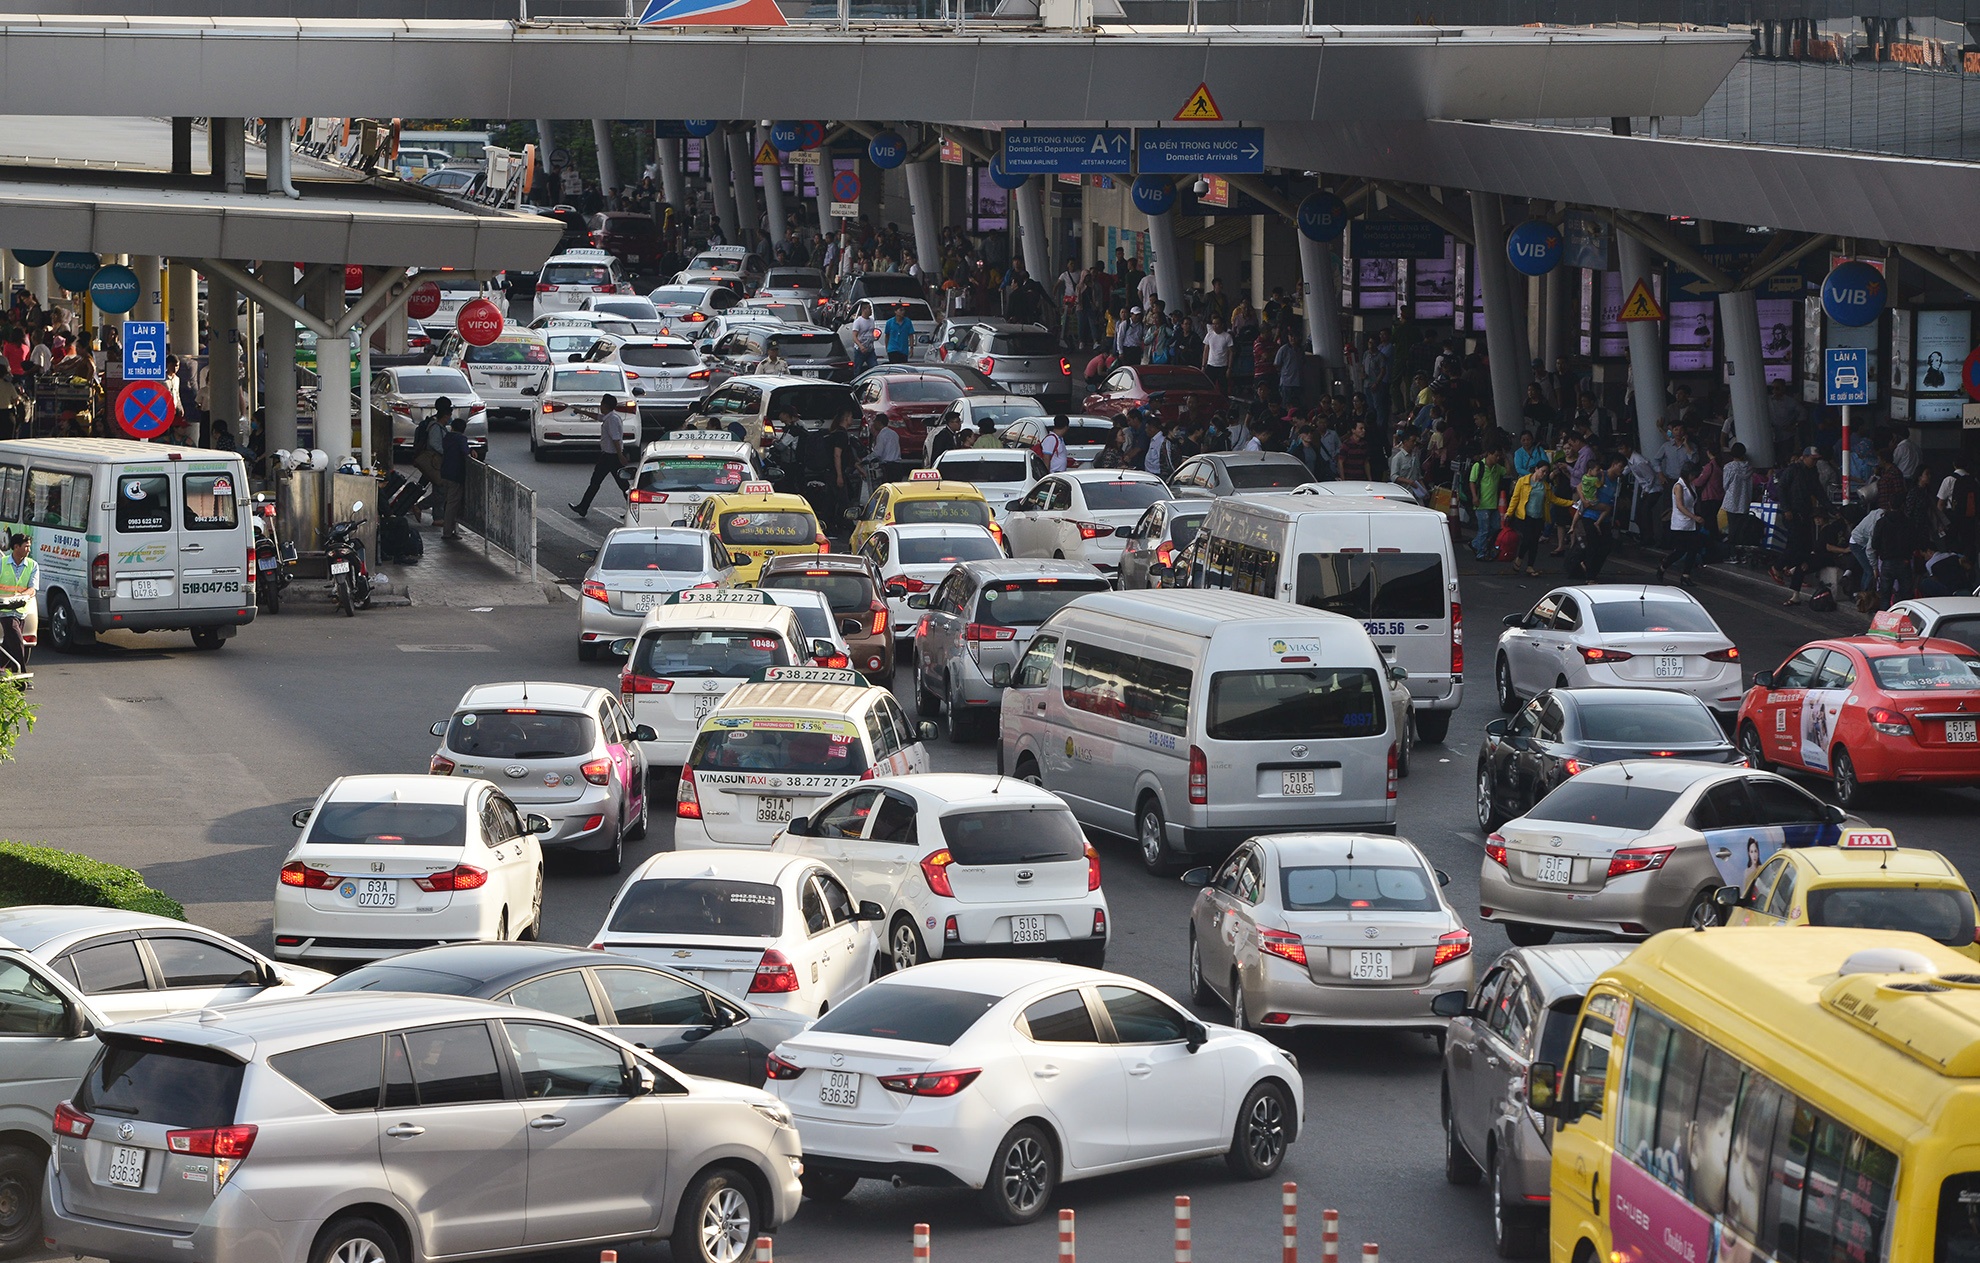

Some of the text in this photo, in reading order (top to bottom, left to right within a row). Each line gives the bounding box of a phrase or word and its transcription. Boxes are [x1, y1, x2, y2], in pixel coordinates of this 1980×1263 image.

[775, 132, 795, 140] VIB
[1008, 135, 1086, 144] GA ĐI TRONG NƯỚC
[1090, 134, 1108, 154] A
[1144, 139, 1238, 150] GA ĐẾN TRONG NƯỚC
[875, 146, 896, 157] VIB
[1044, 146, 1084, 154] Departures
[1138, 188, 1163, 201] VIB
[1305, 213, 1332, 226] VIB
[1516, 242, 1546, 258] VIB
[54, 262, 96, 270] ABBANK
[92, 282, 136, 290] ABBANK
[1832, 287, 1867, 305] VIB
[132, 324, 156, 335] LÀN B
[468, 321, 498, 329] VIFON
[1834, 350, 1850, 362] LÀN
[1964, 416, 1980, 425] KHÔN
[746, 484, 770, 493] TAXI
[755, 526, 796, 535] 36 36 36 36
[40, 544, 51, 553] SPA
[138, 581, 152, 589] 51B
[134, 589, 158, 598] 047.63
[641, 594, 655, 602] 85A
[698, 592, 760, 602] 38.27 27 27
[752, 639, 775, 648] 10484
[1662, 657, 1677, 666] 51G
[786, 670, 854, 681] 38.27 27 27
[1656, 666, 1683, 676] 061.77
[1343, 712, 1373, 727] 4897
[1953, 721, 1969, 732] 51F
[1947, 732, 1976, 742] 813.95
[1074, 744, 1092, 761] VIAGS
[787, 777, 818, 787] 38.27
[822, 778, 836, 787] 27
[837, 778, 855, 788] 27
[1290, 772, 1307, 783] 51B
[1284, 783, 1314, 794] 249.65
[766, 799, 784, 809] 51A
[758, 809, 791, 822] 398.46
[1852, 835, 1888, 845] TAXI
[1545, 859, 1563, 868] 51F
[1538, 869, 1568, 883] 448.09
[368, 880, 388, 892] 63A
[359, 893, 396, 905] 070.75
[1019, 917, 1037, 929] 51G
[1013, 929, 1045, 943] 293.65
[1361, 952, 1382, 964] 51G
[1353, 965, 1388, 978] 457.51
[831, 1074, 850, 1089] 60A
[821, 1088, 856, 1104] 536.35
[119, 1148, 137, 1165] 51G
[110, 1165, 141, 1184] 336.33
[1616, 1194, 1650, 1230] CHUBB
[1664, 1227, 1696, 1263] Chubb Life
